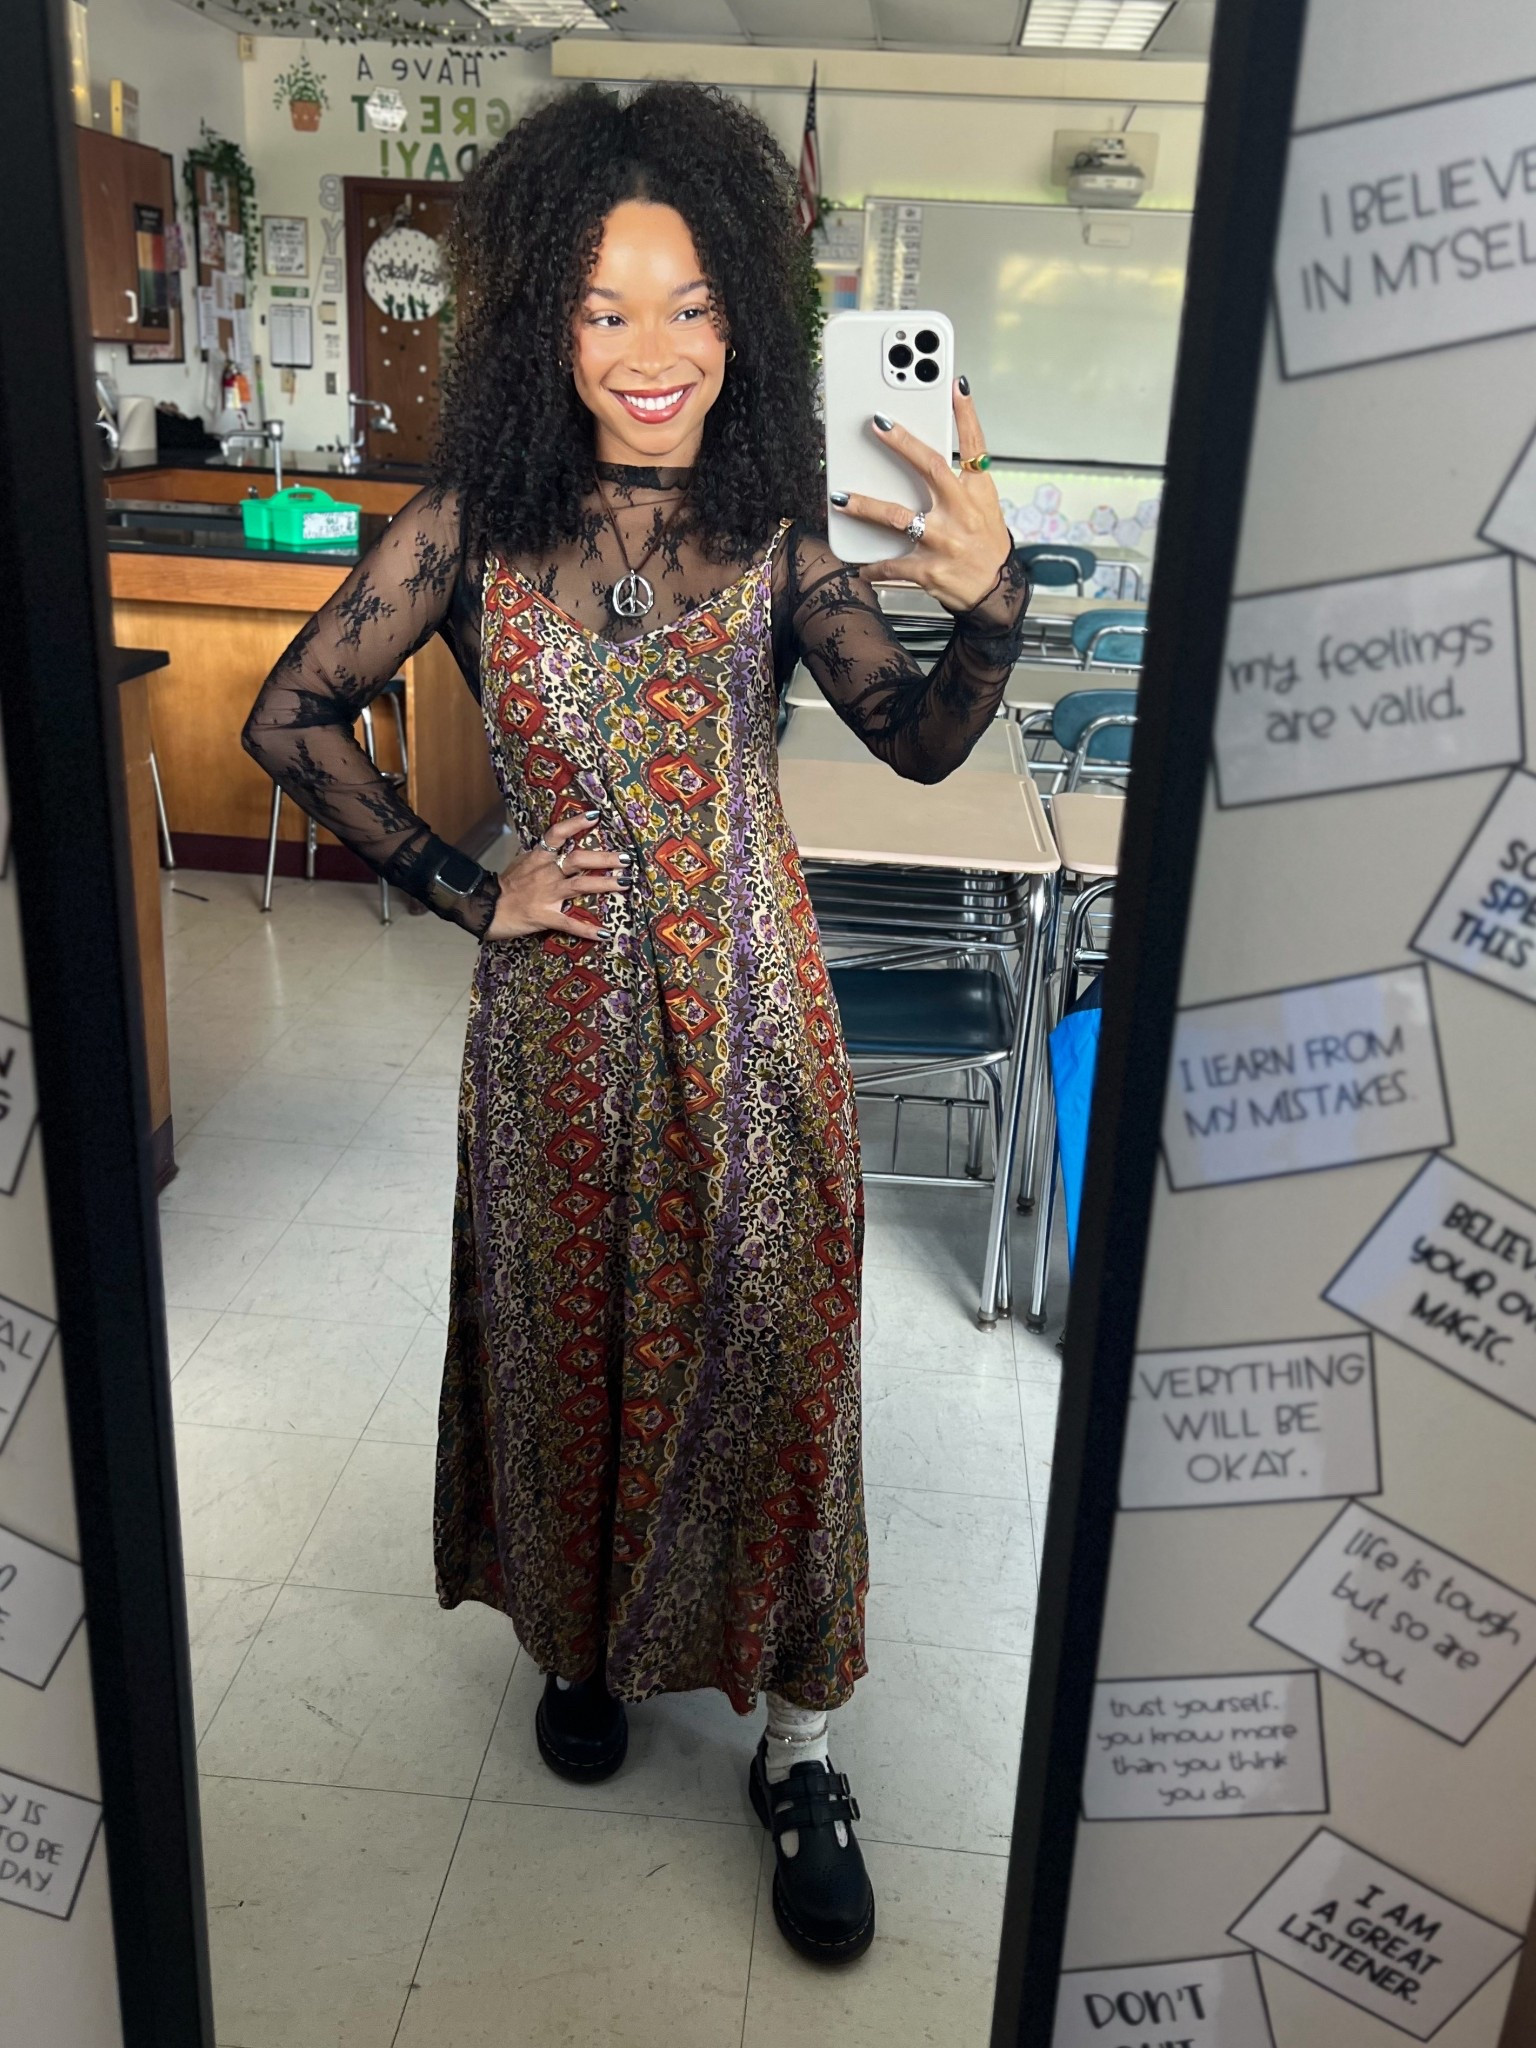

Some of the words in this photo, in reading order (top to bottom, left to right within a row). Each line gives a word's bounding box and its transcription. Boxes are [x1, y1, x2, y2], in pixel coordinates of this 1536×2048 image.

[1321, 191, 1332, 237] I
[1302, 254, 1352, 312] IN
[1228, 653, 1299, 694] my
[1318, 618, 1493, 680] feelings
[1266, 705, 1336, 744] are
[1351, 676, 1465, 731] valid.
[1452, 909, 1534, 969] THIS
[1179, 1059, 1195, 1093] I
[1202, 1043, 1295, 1089] LEARN
[1305, 1026, 1405, 1071] FROM
[1183, 1102, 1238, 1139] MY
[1137, 1353, 1366, 1401] VERYTHING
[1163, 1408, 1261, 1442] WILL
[1275, 1402, 1321, 1436] BE
[1187, 1448, 1308, 1483] OKAY.
[1344, 1529, 1399, 1571] life
[1402, 1559, 1431, 1590] is
[1435, 1577, 1521, 1646] tough
[1332, 1571, 1390, 1620] but
[1390, 1611, 1429, 1641] so
[1434, 1633, 1480, 1669] are
[1342, 1638, 1406, 1685] you
[1109, 1695, 1167, 1718] trust
[1174, 1690, 1279, 1719] yourself.
[1096, 1731, 1144, 1750] you
[1150, 1727, 1224, 1745] know
[1231, 1724, 1298, 1741] more
[1112, 1755, 1167, 1775] than
[1173, 1758, 1221, 1778] you
[1229, 1751, 1287, 1771] think
[22, 1799, 48, 1826] IS
[1158, 1786, 1205, 1806] you
[1213, 1780, 1246, 1800] do.
[35, 1837, 64, 1866] BE
[1354, 1883, 1385, 1909] I
[1381, 1903, 1442, 1943] AM
[1278, 1913, 1421, 2005] LISTENER.
[1311, 1899, 1339, 1924] A
[1345, 1916, 1443, 1976] GREAT
